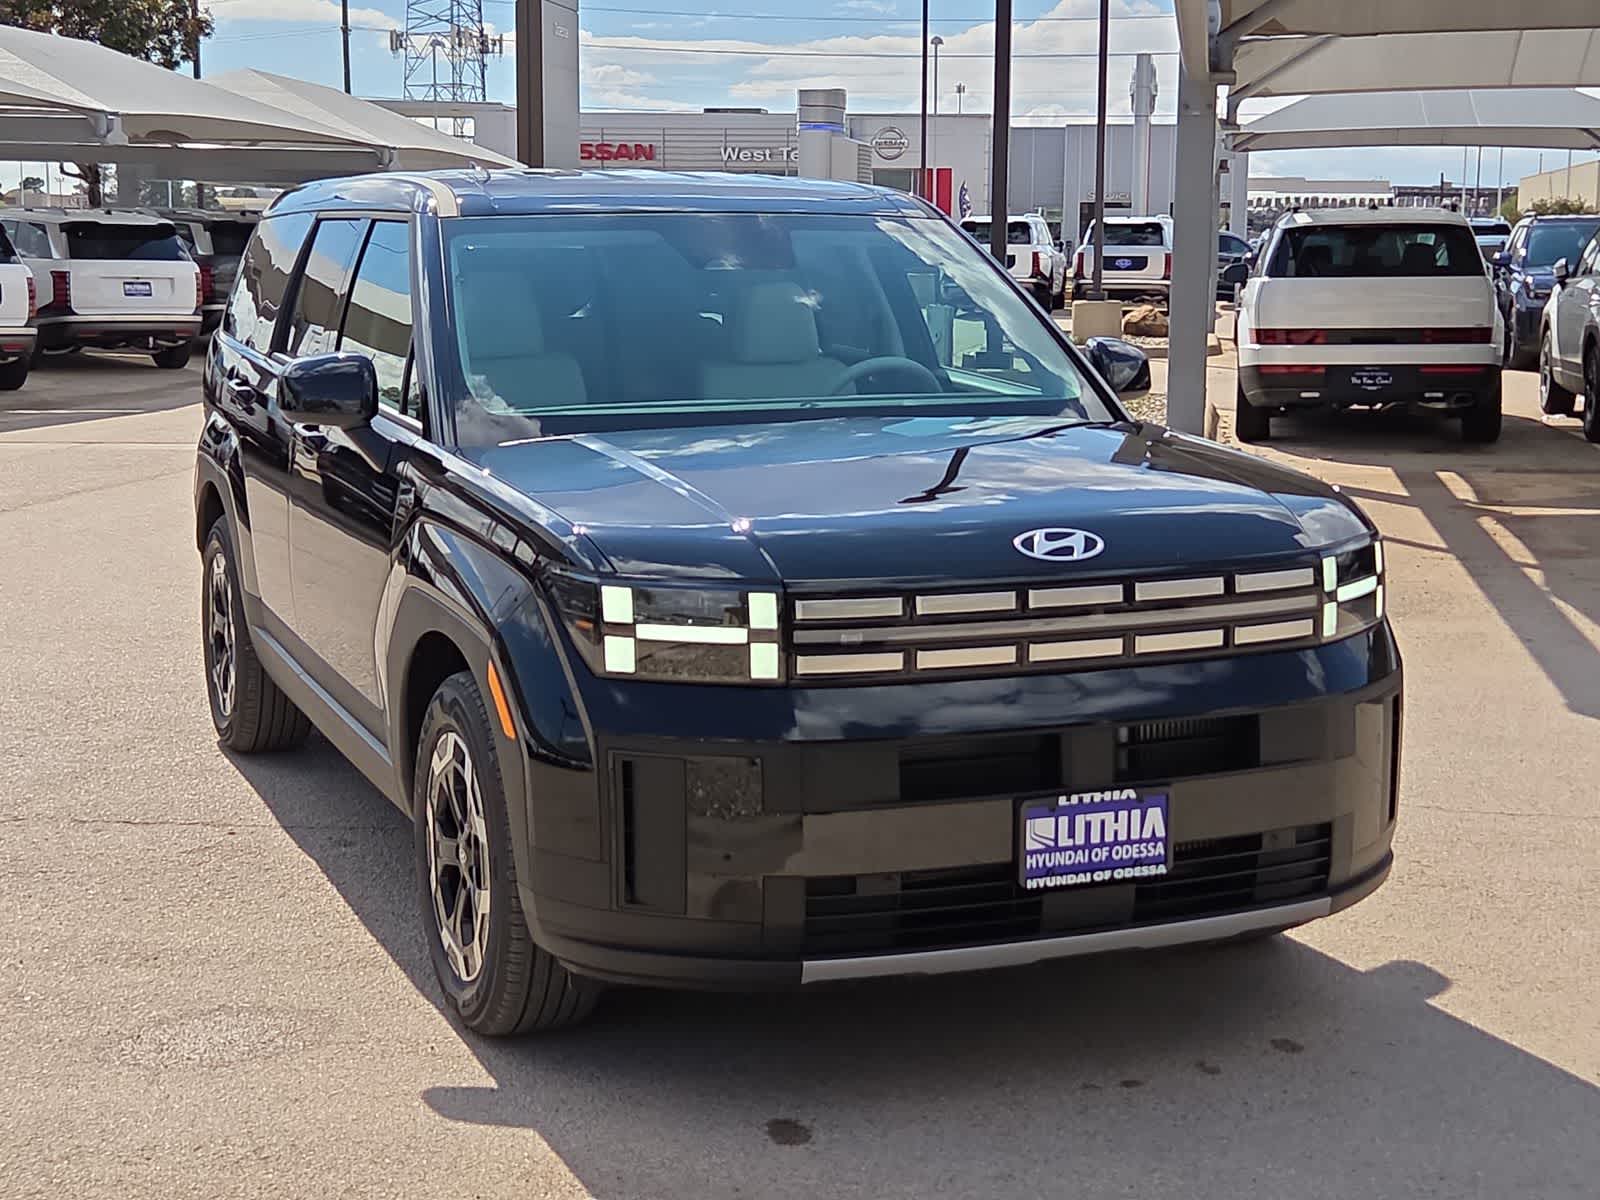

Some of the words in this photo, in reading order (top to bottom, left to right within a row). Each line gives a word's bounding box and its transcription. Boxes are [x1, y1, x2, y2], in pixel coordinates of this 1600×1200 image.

[580, 143, 654, 161] SSAN
[720, 147, 771, 161] West
[778, 147, 799, 161] Te
[1058, 789, 1137, 806] LITHIA
[1057, 807, 1166, 848] LITHIA
[1026, 849, 1090, 870] HYUNDAI
[1091, 847, 1110, 862] OF
[1111, 842, 1165, 861] ODESSA
[1026, 872, 1091, 889] HYUNDAI
[1093, 869, 1112, 882] OF
[1113, 864, 1167, 879] ODESSA
